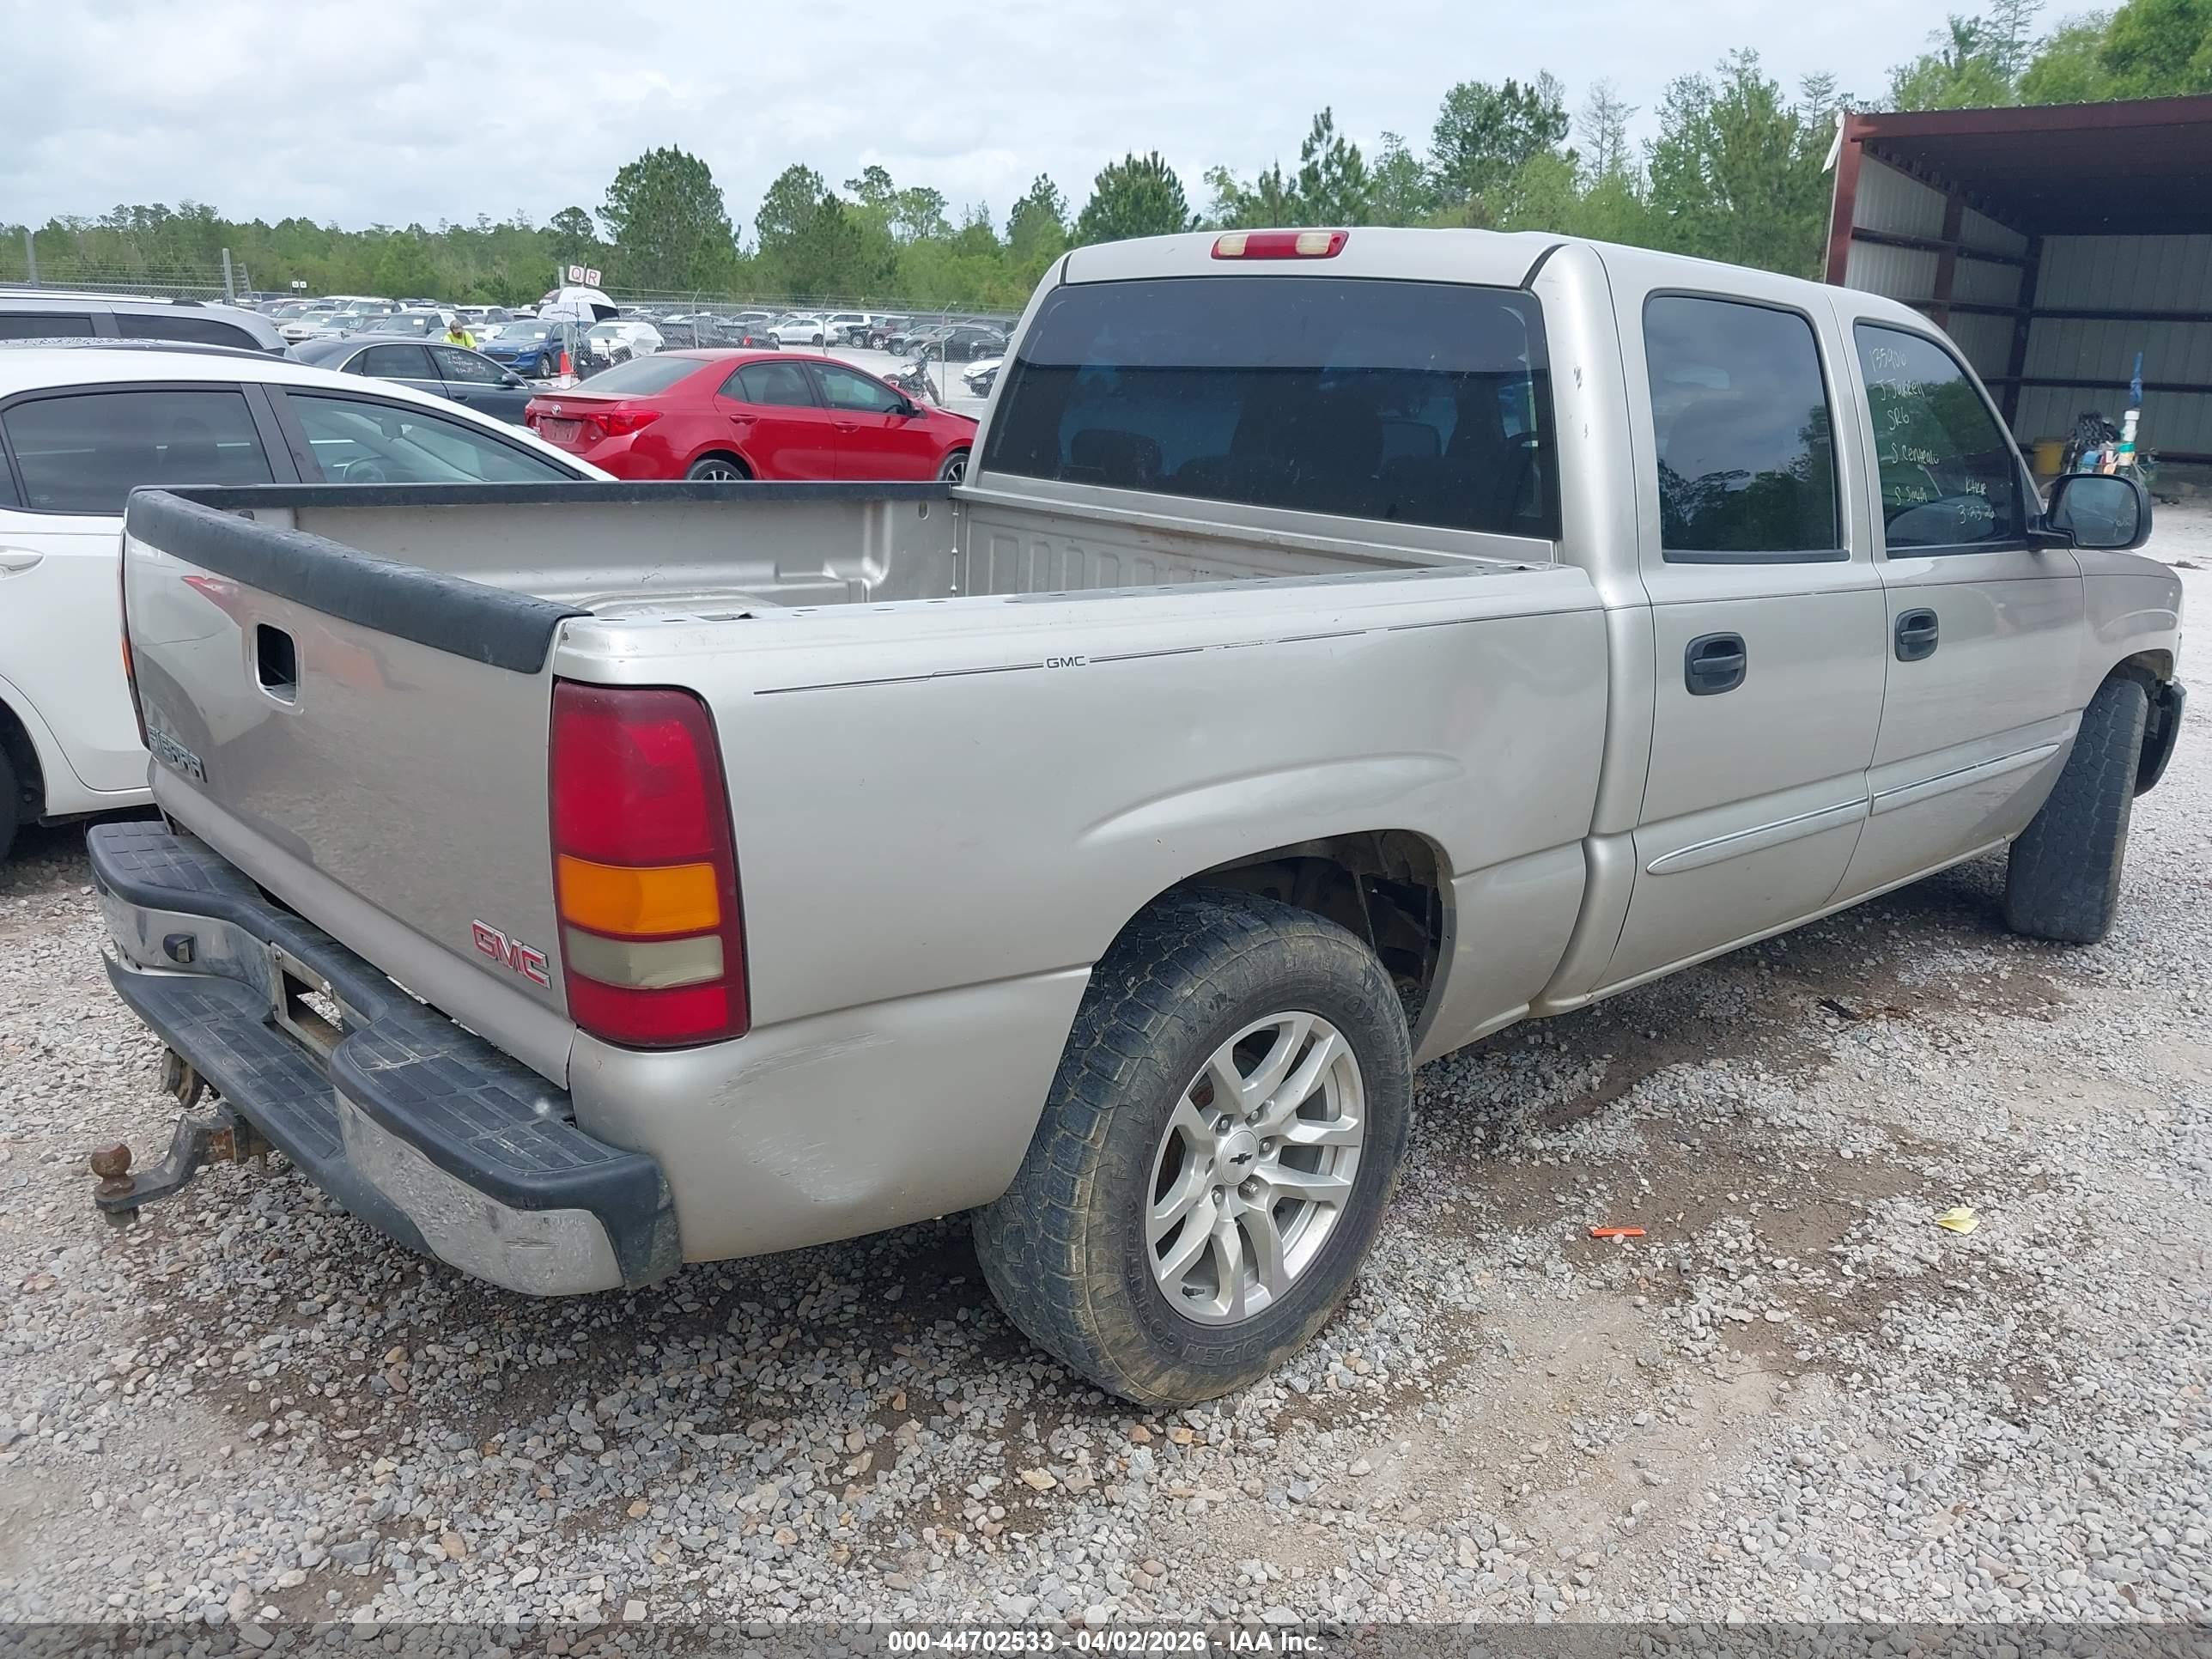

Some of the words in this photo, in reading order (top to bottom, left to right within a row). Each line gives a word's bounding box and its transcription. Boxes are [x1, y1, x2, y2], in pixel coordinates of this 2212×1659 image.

[1887, 406, 1910, 431] SR6
[1047, 655, 1086, 669] GMC
[471, 917, 552, 989] GMC
[1181, 1337, 1266, 1367] OPEN
